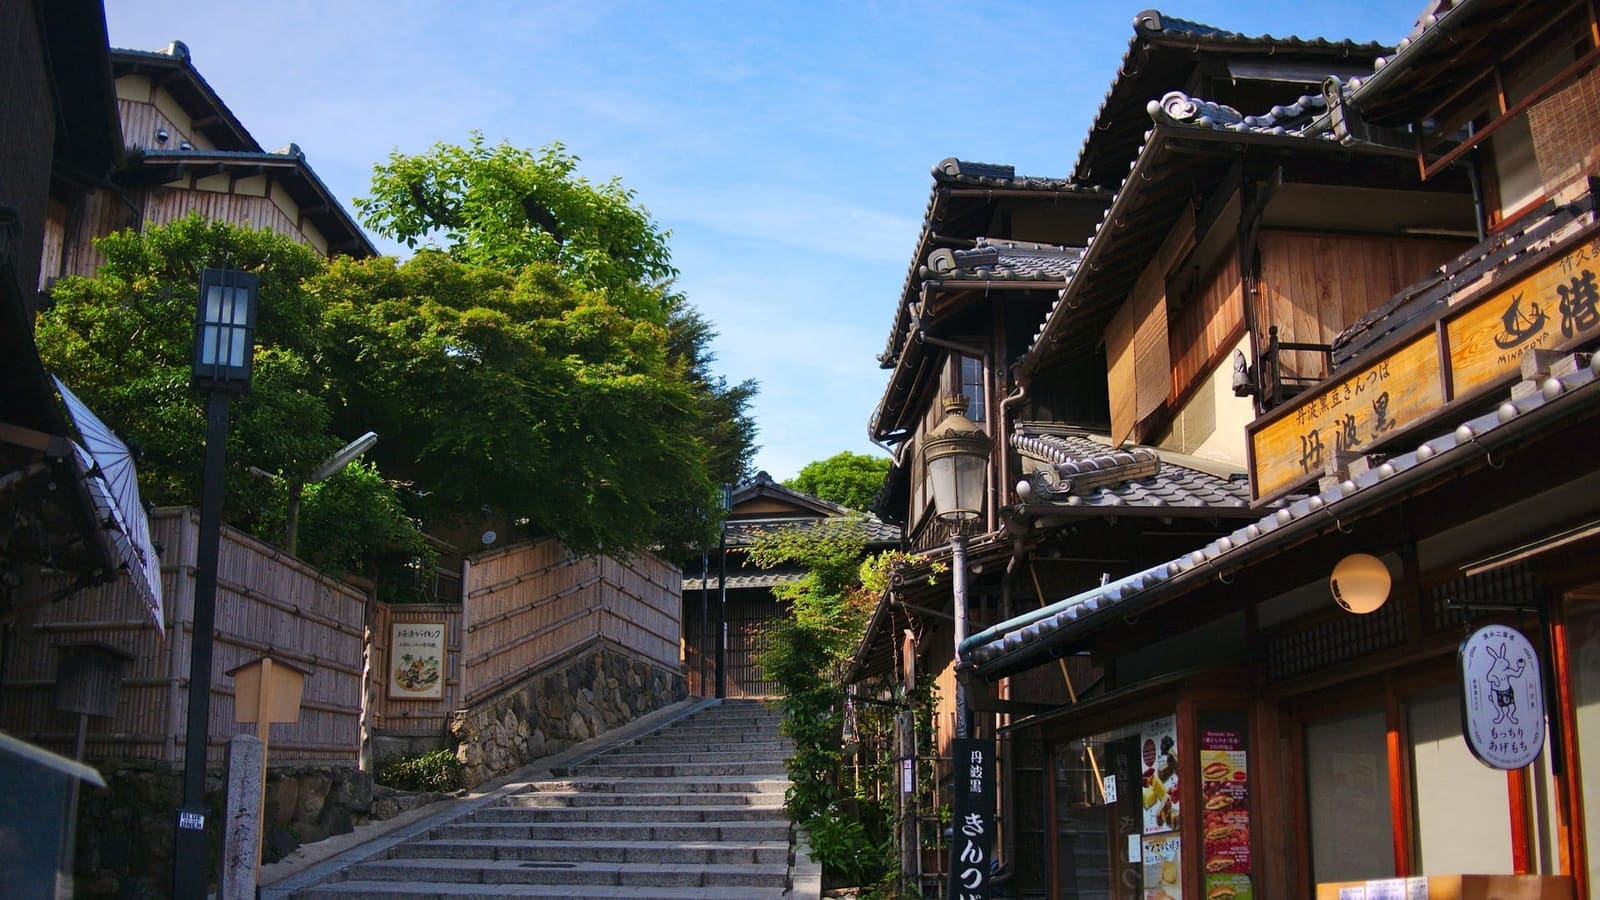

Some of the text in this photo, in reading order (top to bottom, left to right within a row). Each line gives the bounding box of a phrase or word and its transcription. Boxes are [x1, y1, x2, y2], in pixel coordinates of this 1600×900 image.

[1497, 332, 1550, 365] MINATOYA
[1296, 359, 1391, 426] 丹波黒豆きんつば
[1299, 391, 1397, 474] 丹波黒
[1489, 741, 1528, 754] あげもち
[1491, 727, 1524, 740] もっちり
[969, 750, 983, 793] 丹波黒
[959, 812, 985, 900] きんつ
